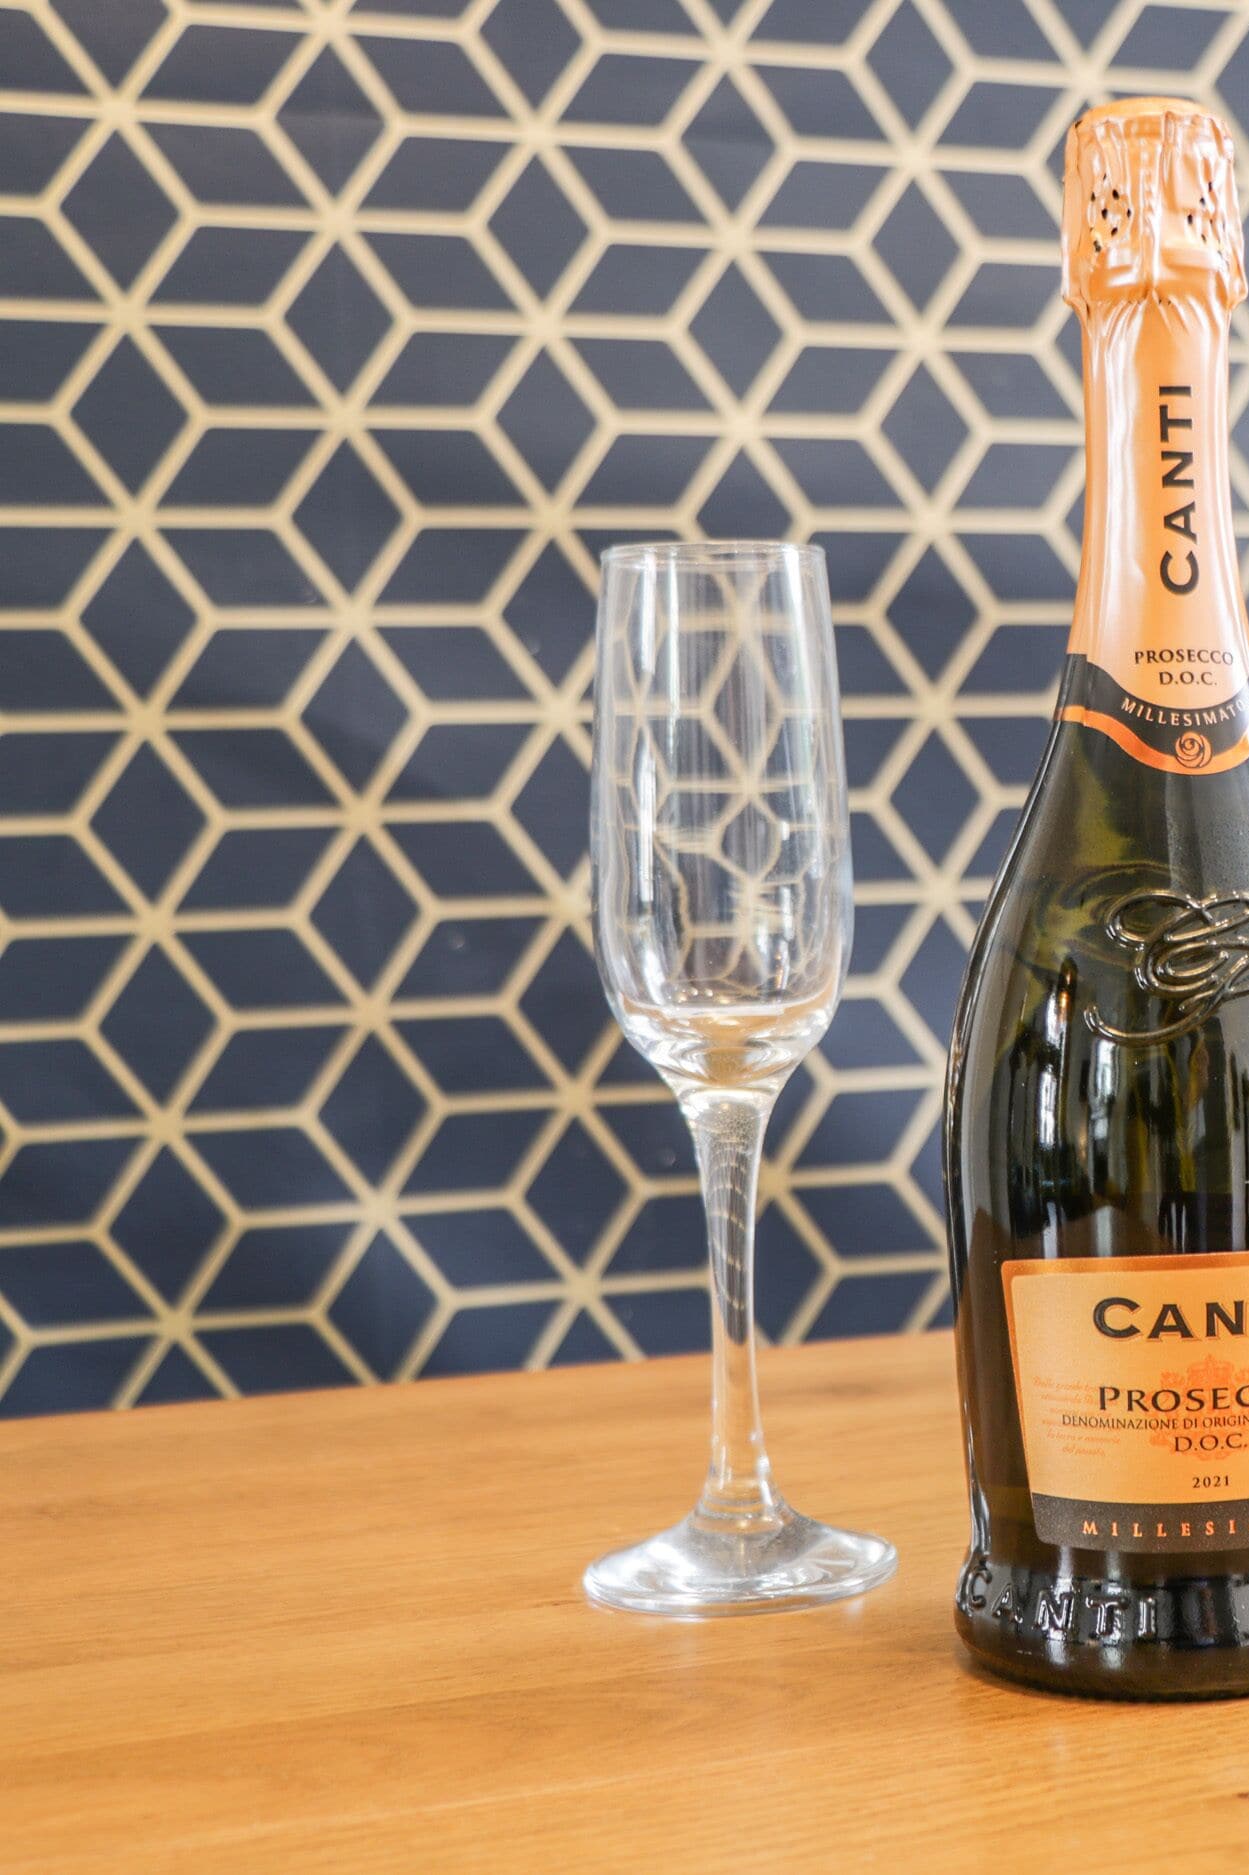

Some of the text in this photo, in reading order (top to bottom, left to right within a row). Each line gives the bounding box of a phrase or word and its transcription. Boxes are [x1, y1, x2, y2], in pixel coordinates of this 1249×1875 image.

[1159, 384, 1200, 595] CANTI
[1134, 649, 1234, 666] PROSECCO
[1158, 671, 1218, 686] D.O.C.
[1120, 697, 1246, 727] MILLESIMATO
[1061, 1413, 1180, 1430] DENOMINAZIONE
[1182, 1415, 1198, 1429] DI
[1173, 1432, 1249, 1454] D.O.C.
[1191, 1475, 1231, 1489] 2021
[960, 1563, 1159, 1641] CANTI
